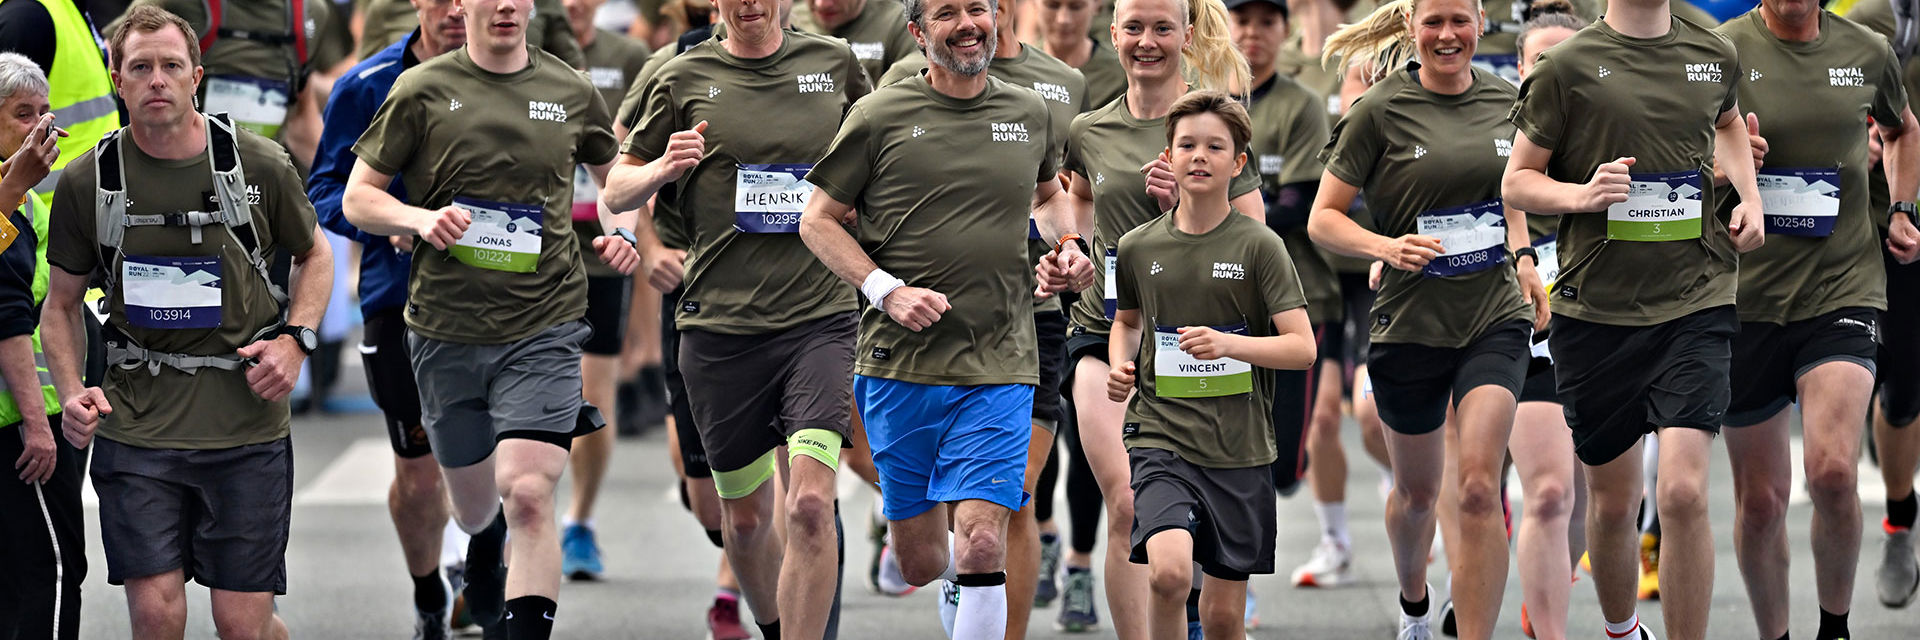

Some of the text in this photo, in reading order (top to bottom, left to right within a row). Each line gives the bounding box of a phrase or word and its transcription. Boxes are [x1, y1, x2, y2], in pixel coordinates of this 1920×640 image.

[1686, 64, 1722, 72] ROYAL
[1828, 68, 1863, 77] ROYAL
[797, 73, 833, 84] ROYAL
[1034, 82, 1069, 96] ROYAL
[529, 101, 566, 114] ROYAL
[991, 123, 1027, 132] ROYAL
[746, 192, 804, 206] HENRIK
[1628, 208, 1685, 218] CHRISTIAN
[1773, 216, 1815, 228] 102548
[1654, 224, 1660, 234] 3
[476, 236, 512, 247] JONAS
[474, 249, 512, 263] 101224
[1448, 251, 1488, 267] 103088
[1213, 262, 1244, 272] ROYAL
[1546, 269, 1560, 280] JO
[150, 309, 191, 320] 103914
[1178, 363, 1226, 373] VINCENT
[1200, 378, 1207, 388] 5
[812, 441, 828, 450] PRO
